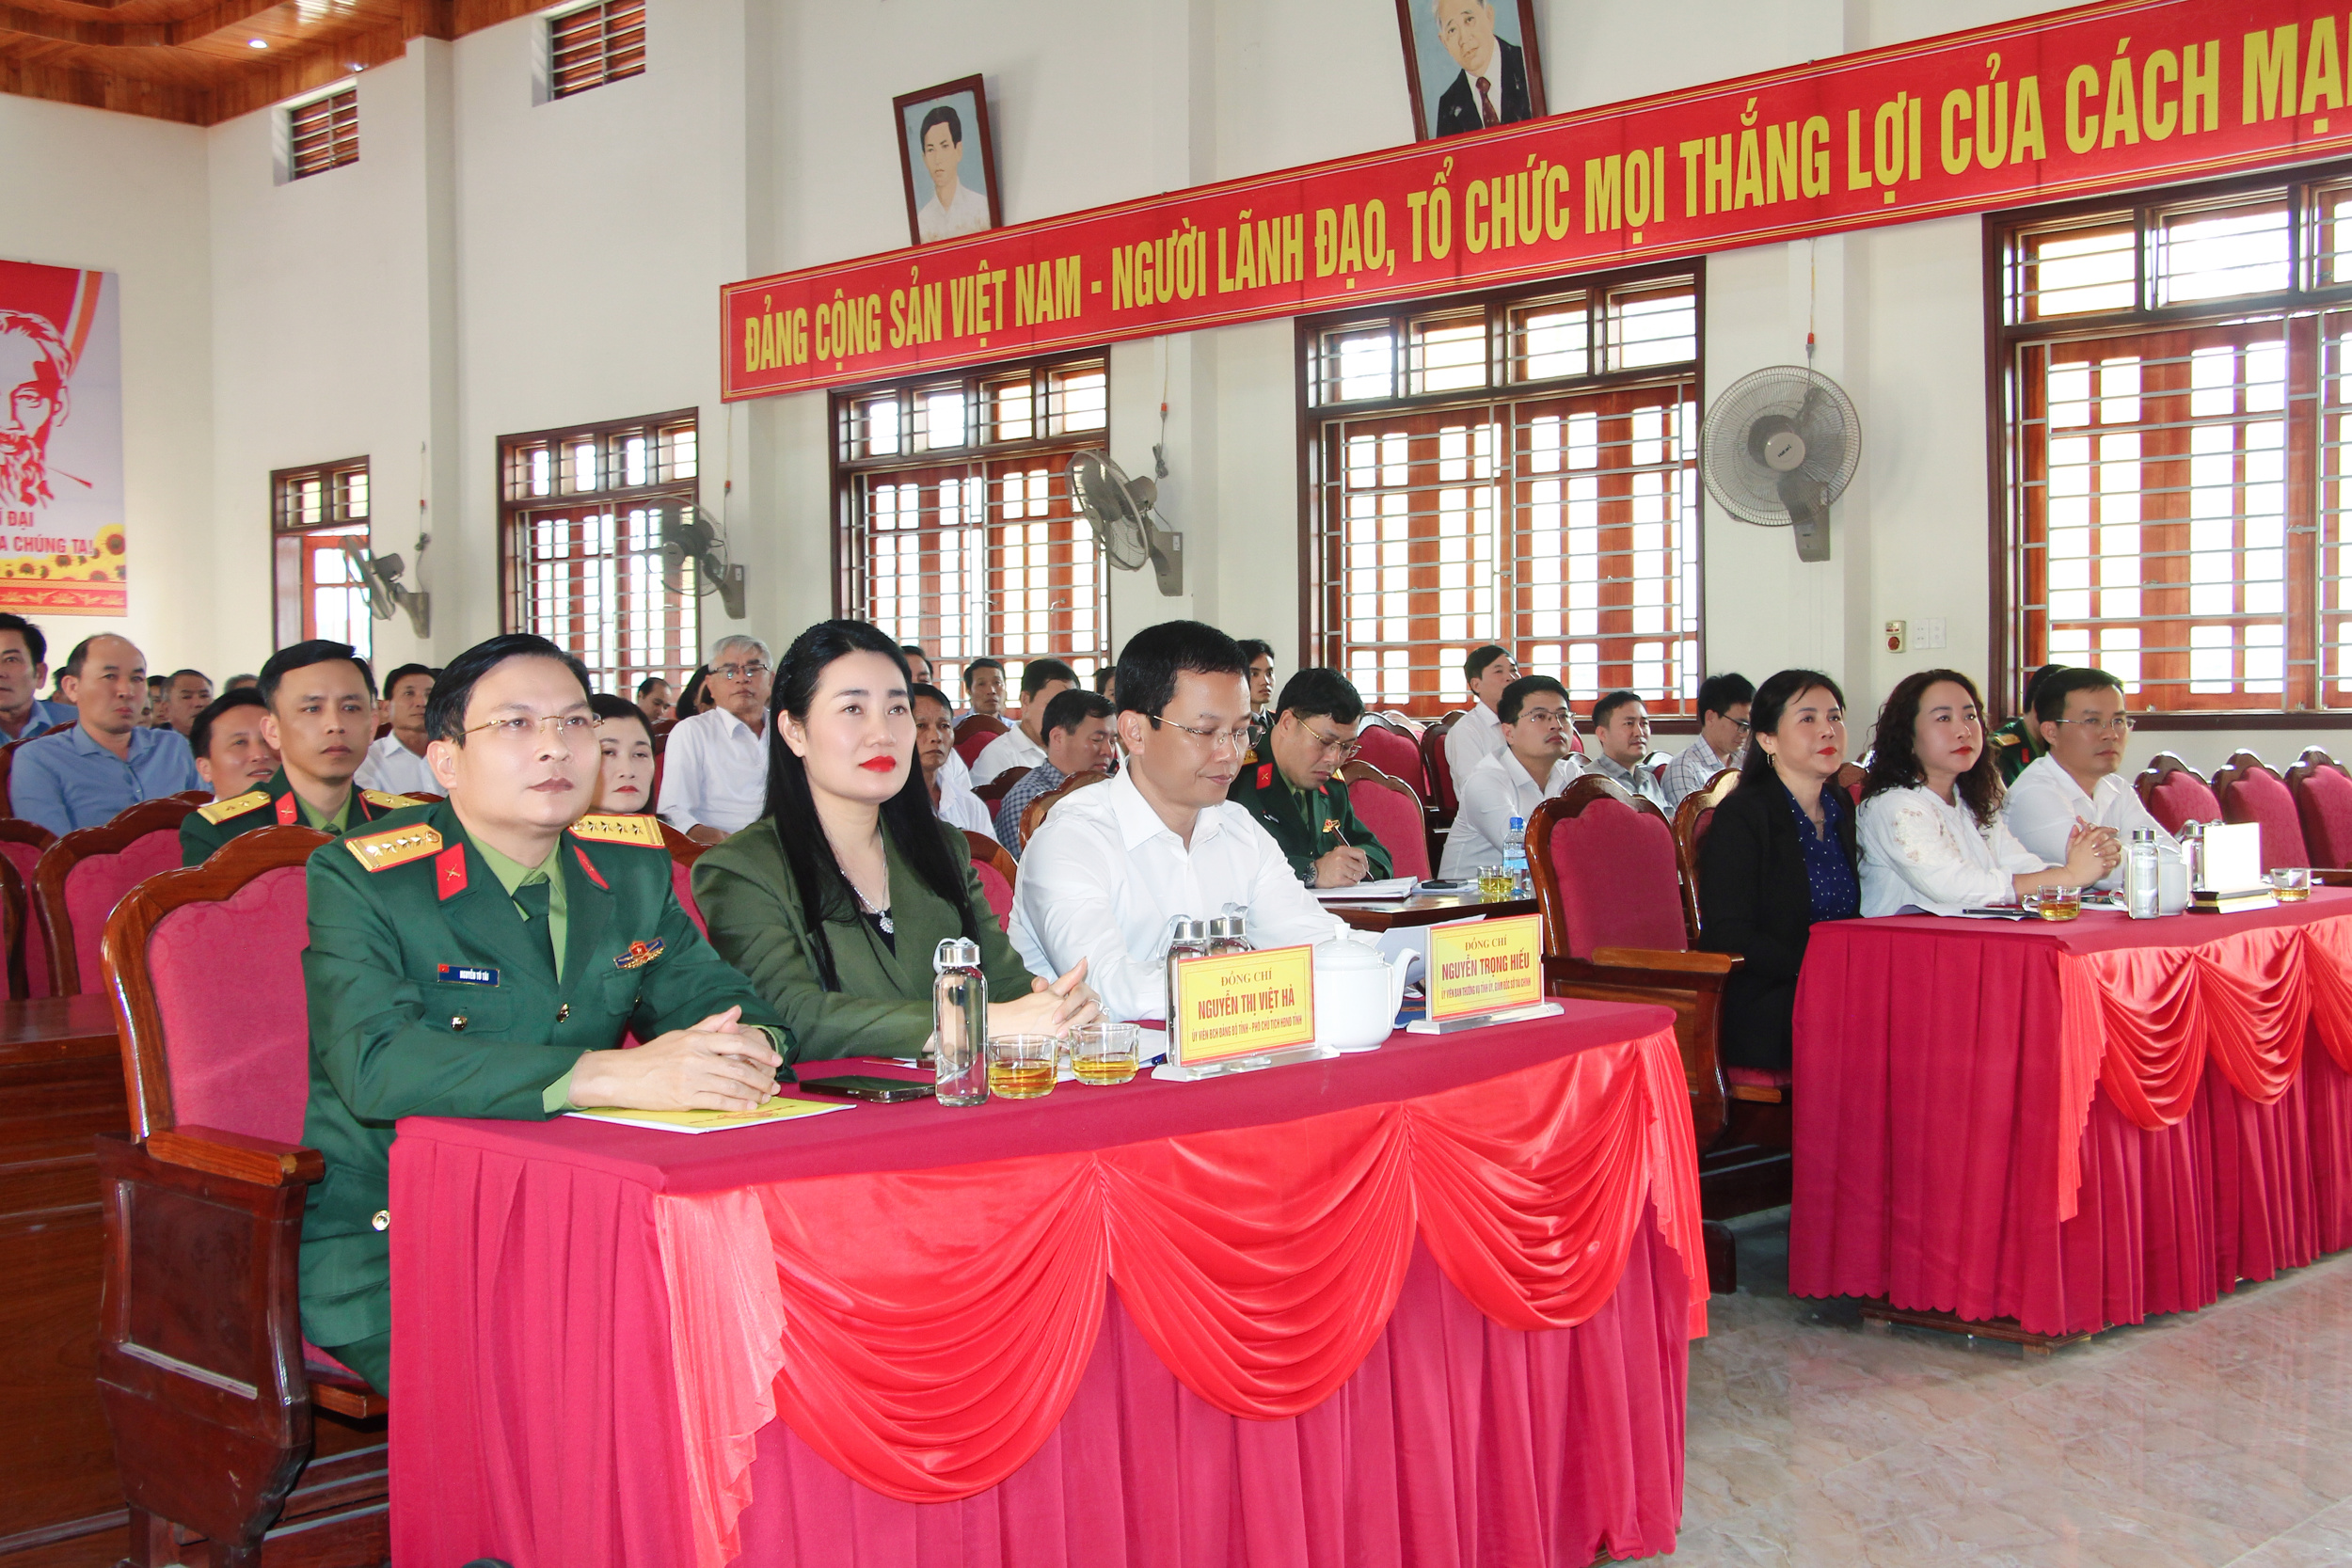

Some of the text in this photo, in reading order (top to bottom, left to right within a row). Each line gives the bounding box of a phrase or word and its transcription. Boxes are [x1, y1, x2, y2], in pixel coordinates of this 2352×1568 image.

[744, 11, 2352, 372] ĐẢNG CỘNG SẢN VIỆT NAM - NGƯỜI LÃNH ĐẠO, TỔ CHỨC MỌI THẮNG LỢI CỦA CÁCH MẠ
[13, 533, 67, 553] CHÚNG
[71, 538, 93, 554] TA!
[1465, 934, 1507, 951] ĐỒNG CHÍ
[1221, 967, 1272, 987] ĐỒNG CHÍ
[1441, 947, 1530, 981] NGUYỄN TRỌNG HIẾU
[1198, 983, 1295, 1021] NGUYỄN THỊ VIỆT HÀ
